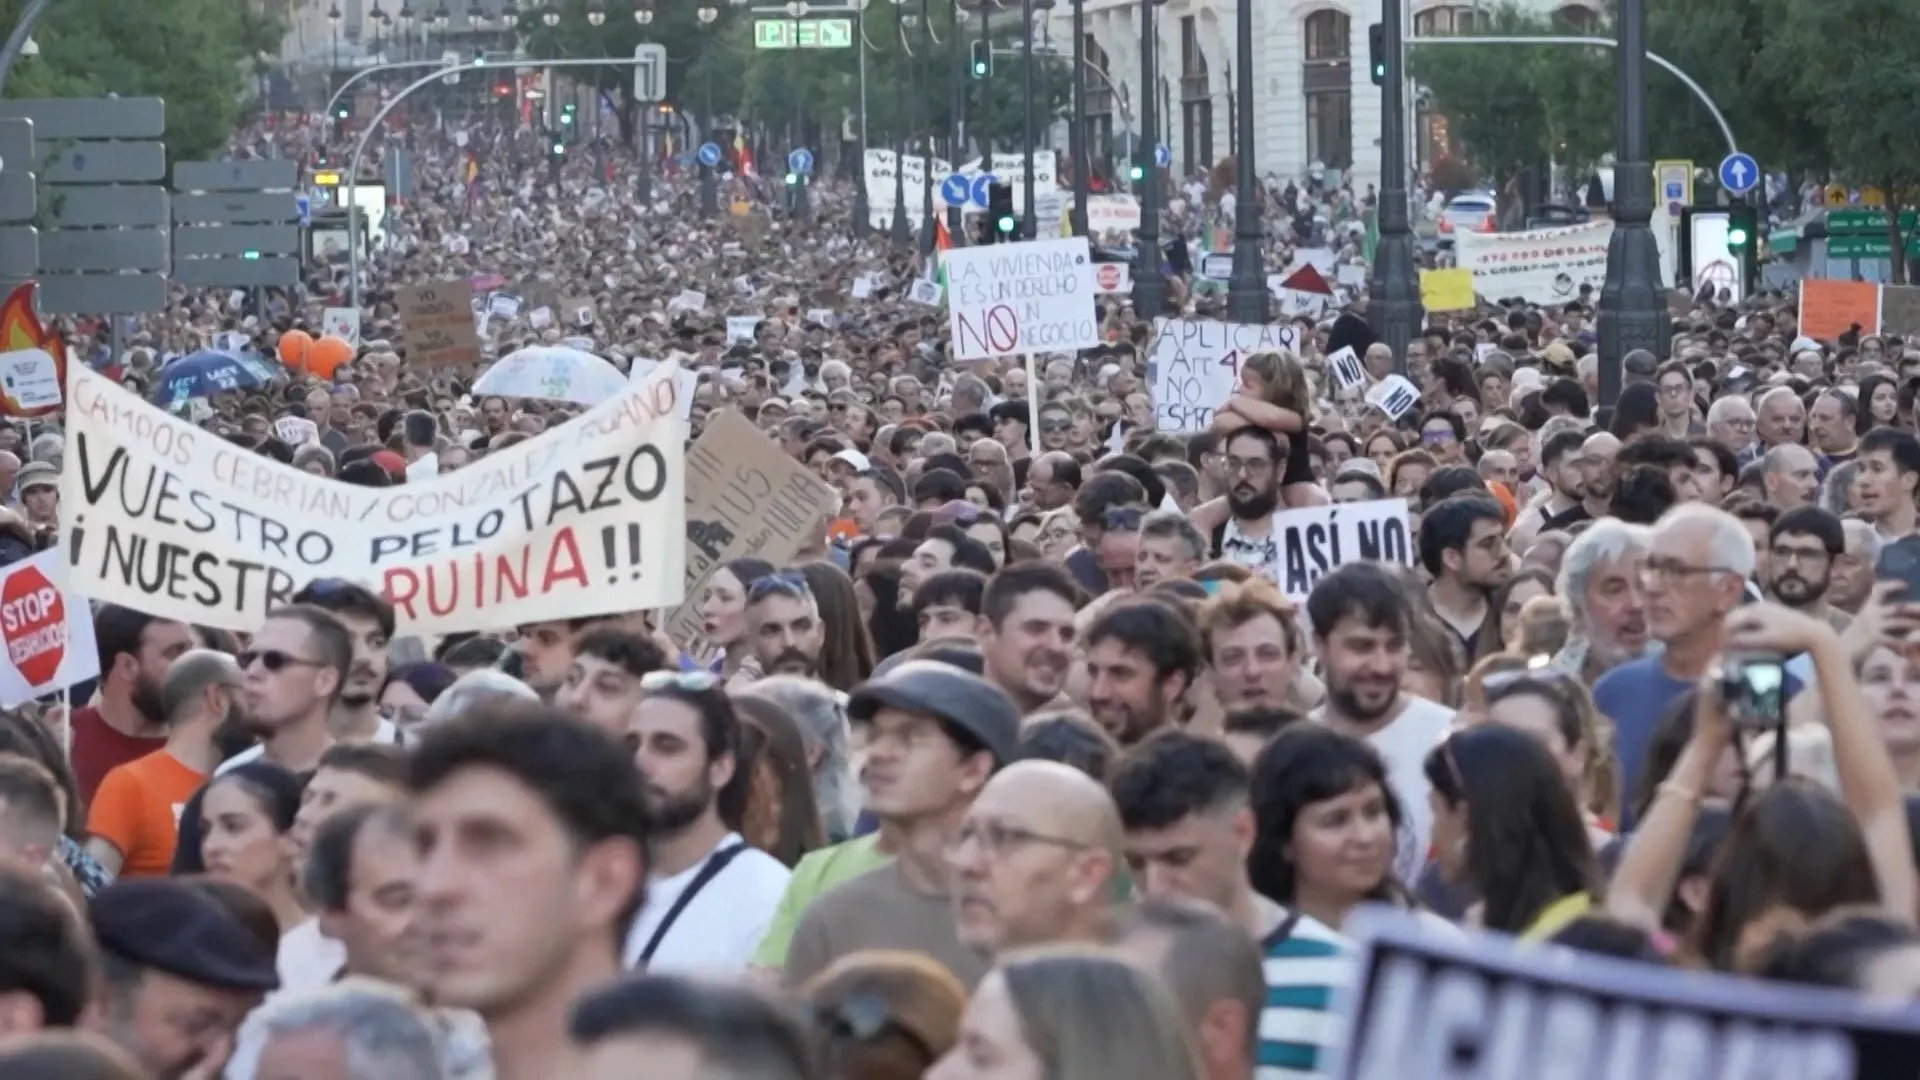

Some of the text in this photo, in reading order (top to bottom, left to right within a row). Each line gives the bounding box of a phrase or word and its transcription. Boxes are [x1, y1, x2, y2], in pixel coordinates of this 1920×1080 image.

[950, 260, 981, 282] LA
[989, 251, 1074, 278] VIVIENDA
[1016, 301, 1041, 324] UN
[957, 303, 1018, 356] NO
[1020, 318, 1093, 347] NEGOCIO
[1156, 319, 1295, 354] APLICAR
[1219, 349, 1239, 378] 4
[1335, 355, 1361, 385] NO
[1166, 375, 1202, 405] NO
[1383, 385, 1413, 415] NO
[73, 377, 196, 466] CAMPOS
[212, 447, 350, 521] CEBRIAN
[77, 431, 667, 566] VUESTRO PELOTAZO
[1285, 509, 1341, 594] ASÍ
[1357, 516, 1407, 564] NO
[2, 586, 57, 632] STOP
